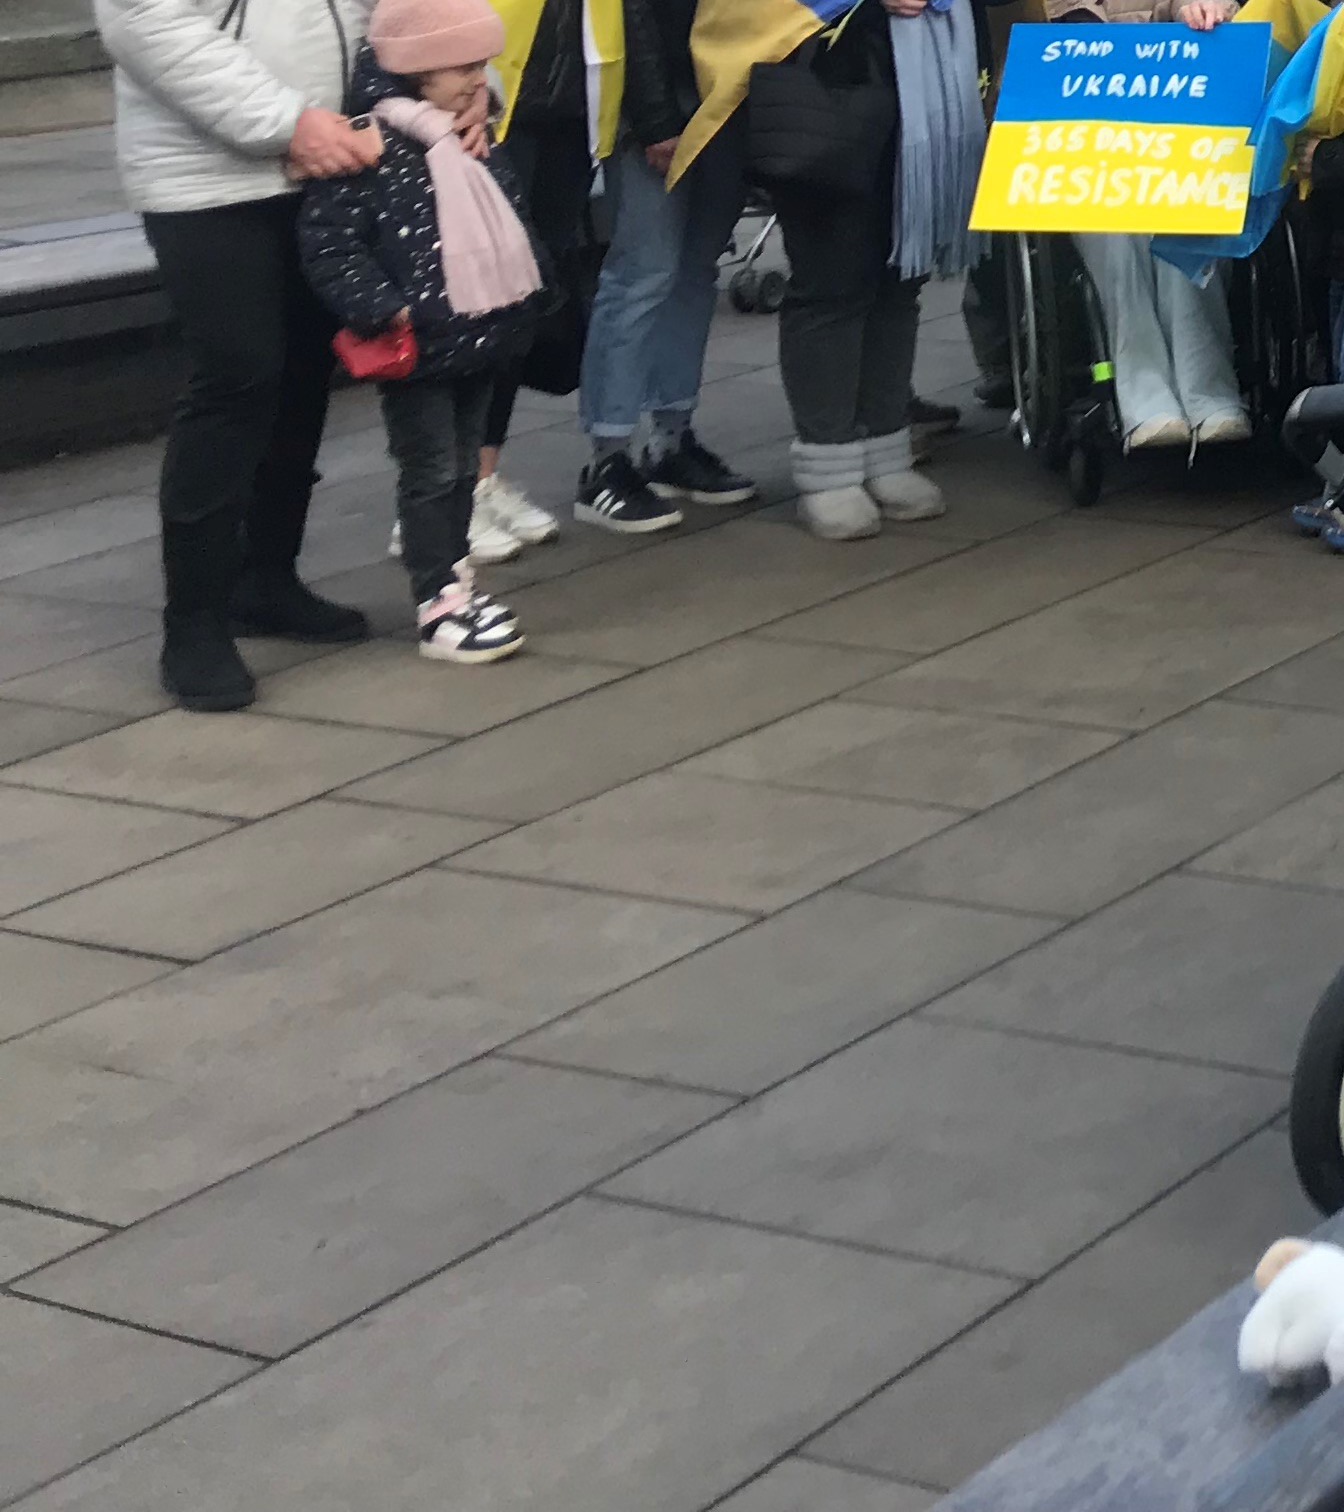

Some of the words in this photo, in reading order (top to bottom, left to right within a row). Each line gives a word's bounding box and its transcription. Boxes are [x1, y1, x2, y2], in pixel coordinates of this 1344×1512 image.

[1041, 39, 1114, 62] STAND
[1135, 40, 1200, 62] WITH
[1062, 73, 1209, 98] UKRAINE
[1022, 124, 1089, 156] 365
[1093, 126, 1176, 159] DAYS
[1190, 136, 1239, 162] OF
